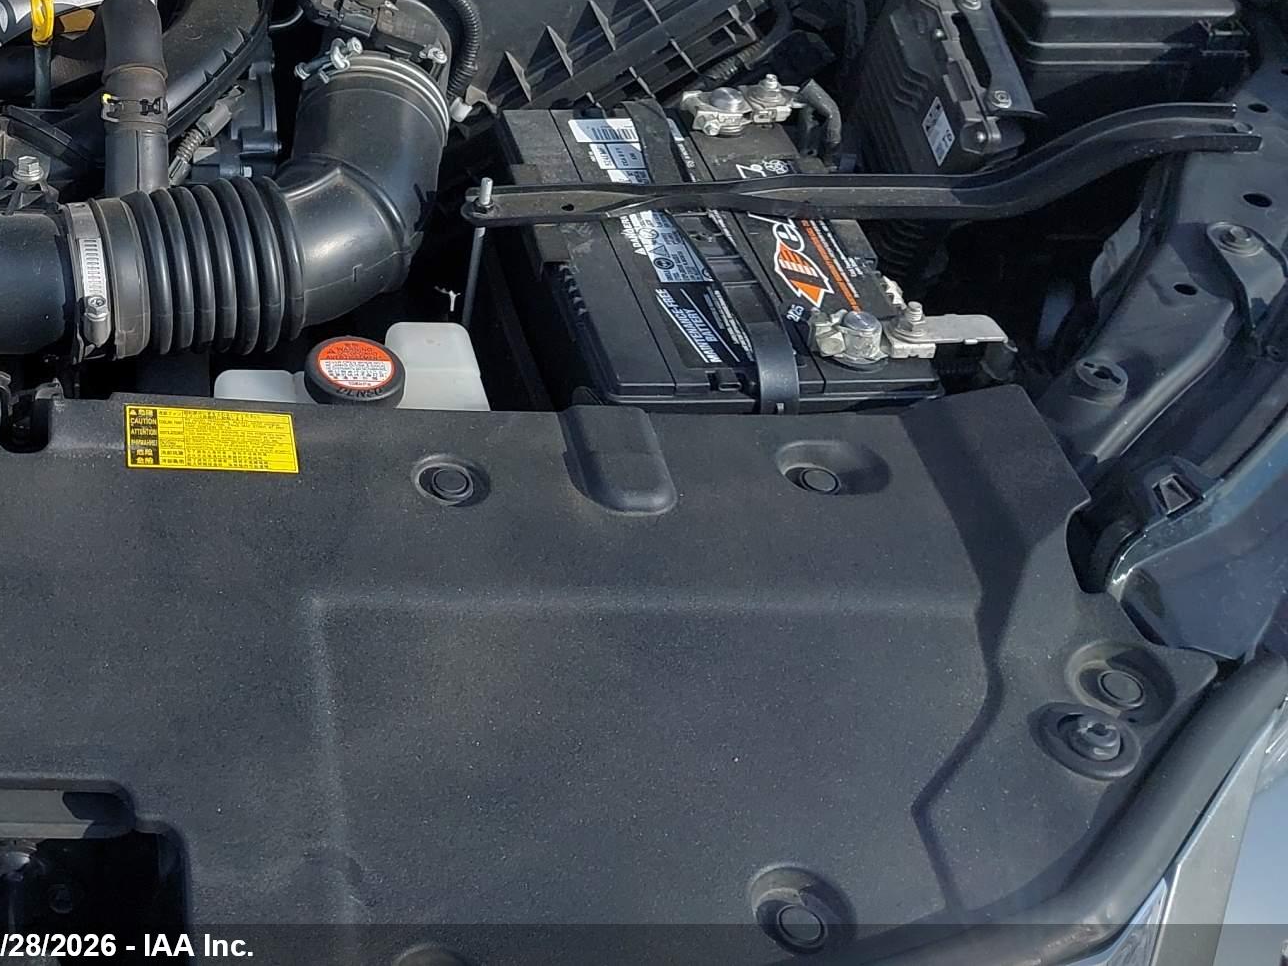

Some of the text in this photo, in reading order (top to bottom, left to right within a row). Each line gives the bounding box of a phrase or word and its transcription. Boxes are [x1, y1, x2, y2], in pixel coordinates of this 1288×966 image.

[654, 288, 723, 363] MAINTENANCE-FREE
[683, 307, 719, 343] BATTERY
[130, 417, 157, 426] CAUTION
[130, 428, 158, 436] ATTENTION
